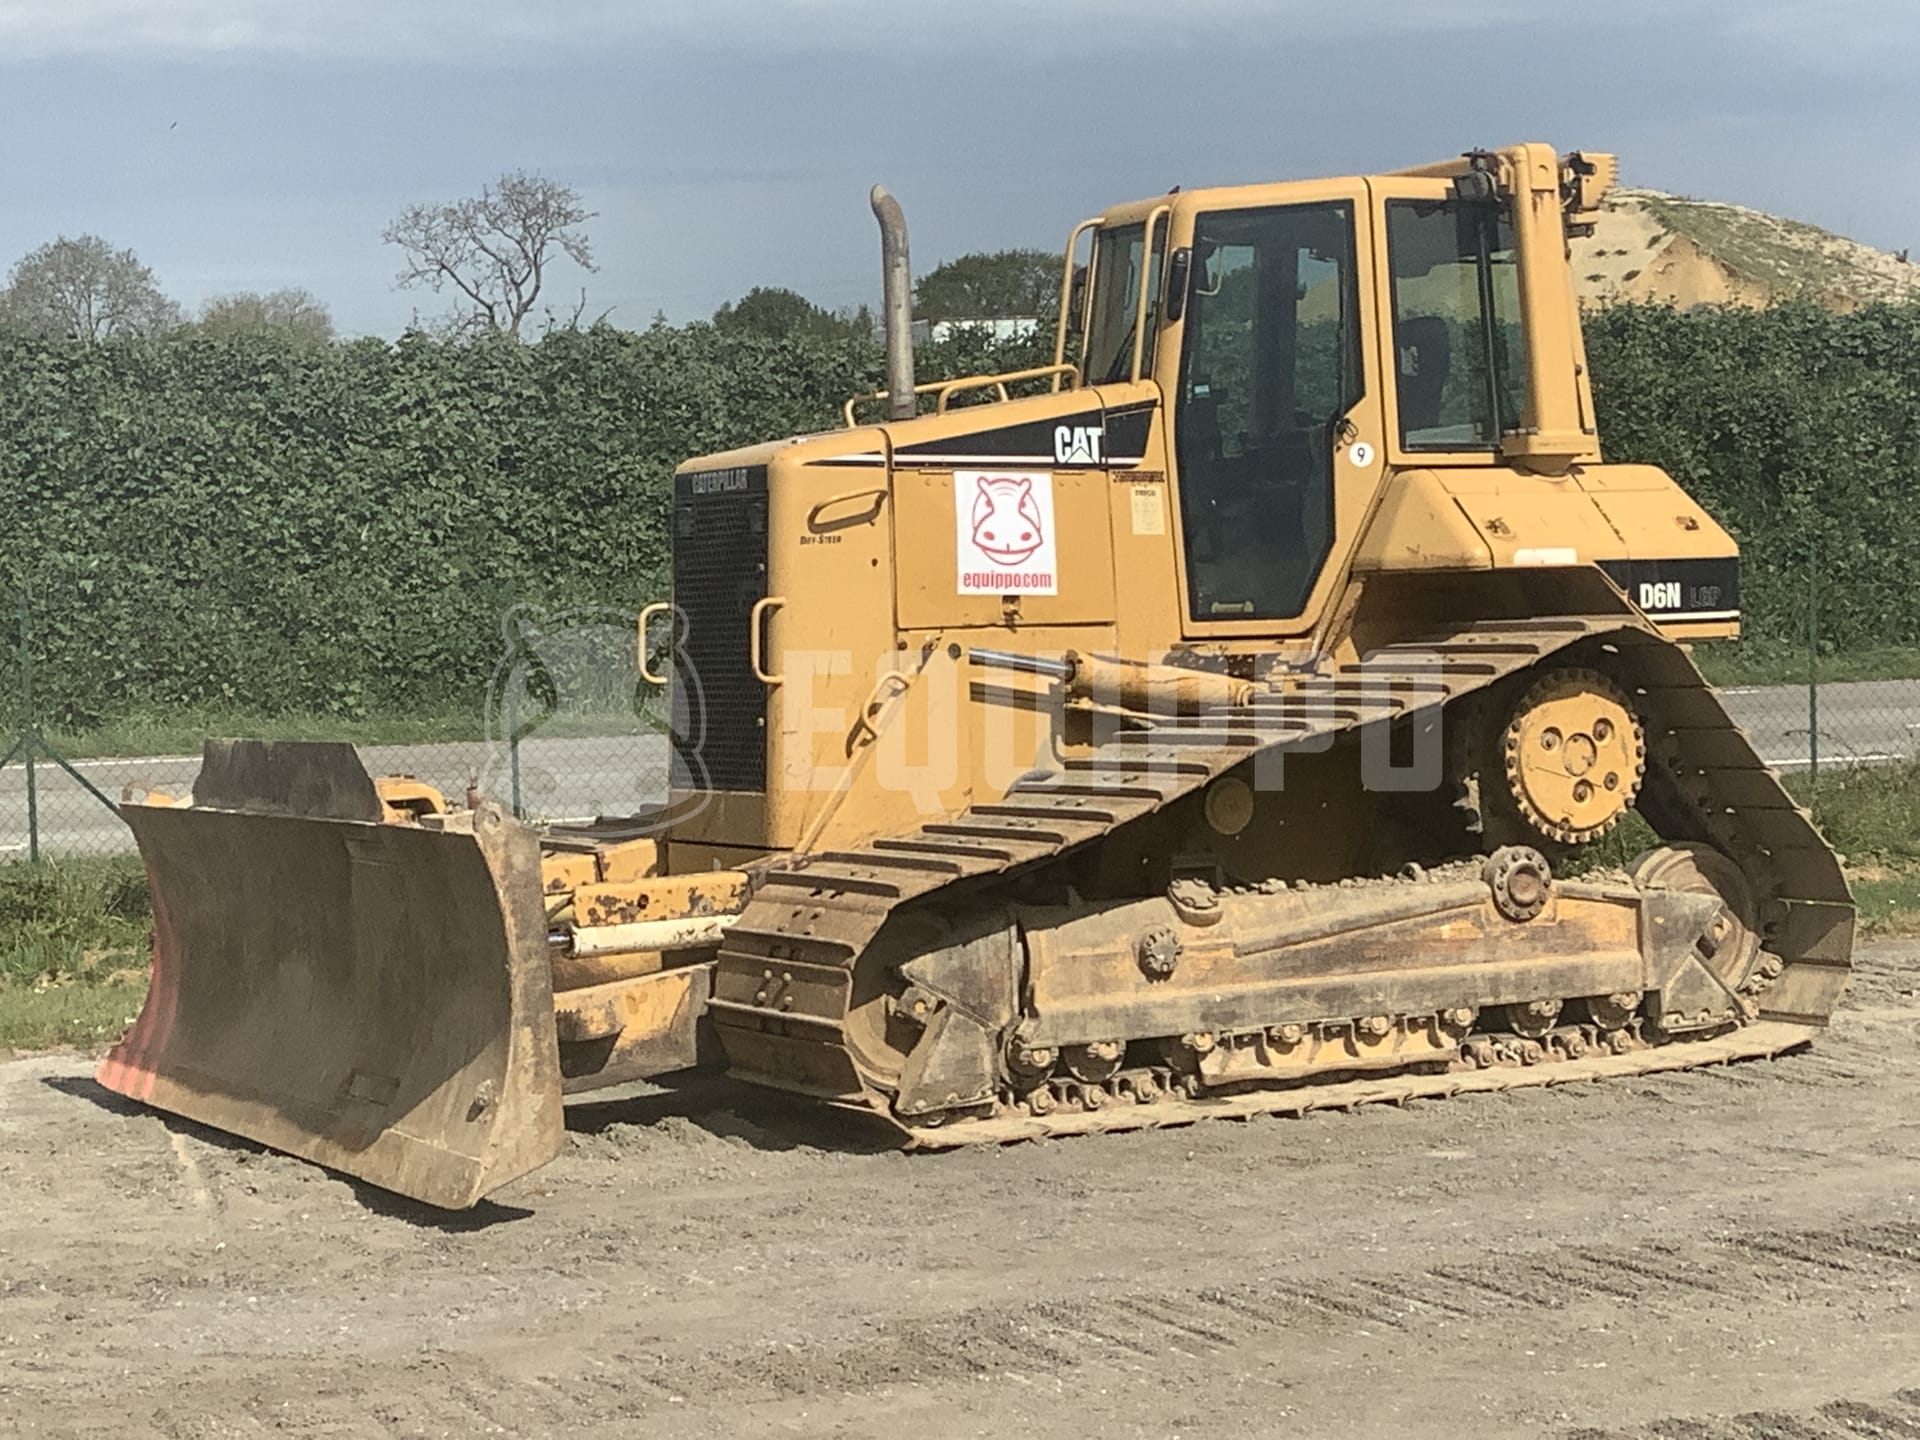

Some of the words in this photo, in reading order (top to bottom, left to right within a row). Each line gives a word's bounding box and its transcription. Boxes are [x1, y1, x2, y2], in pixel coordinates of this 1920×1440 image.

[1055, 425, 1104, 464] CAT
[1357, 446, 1366, 463] 9
[692, 468, 749, 494] CATERPILLAR
[963, 570, 1052, 589] equippo.com
[1640, 582, 1681, 609] D6N
